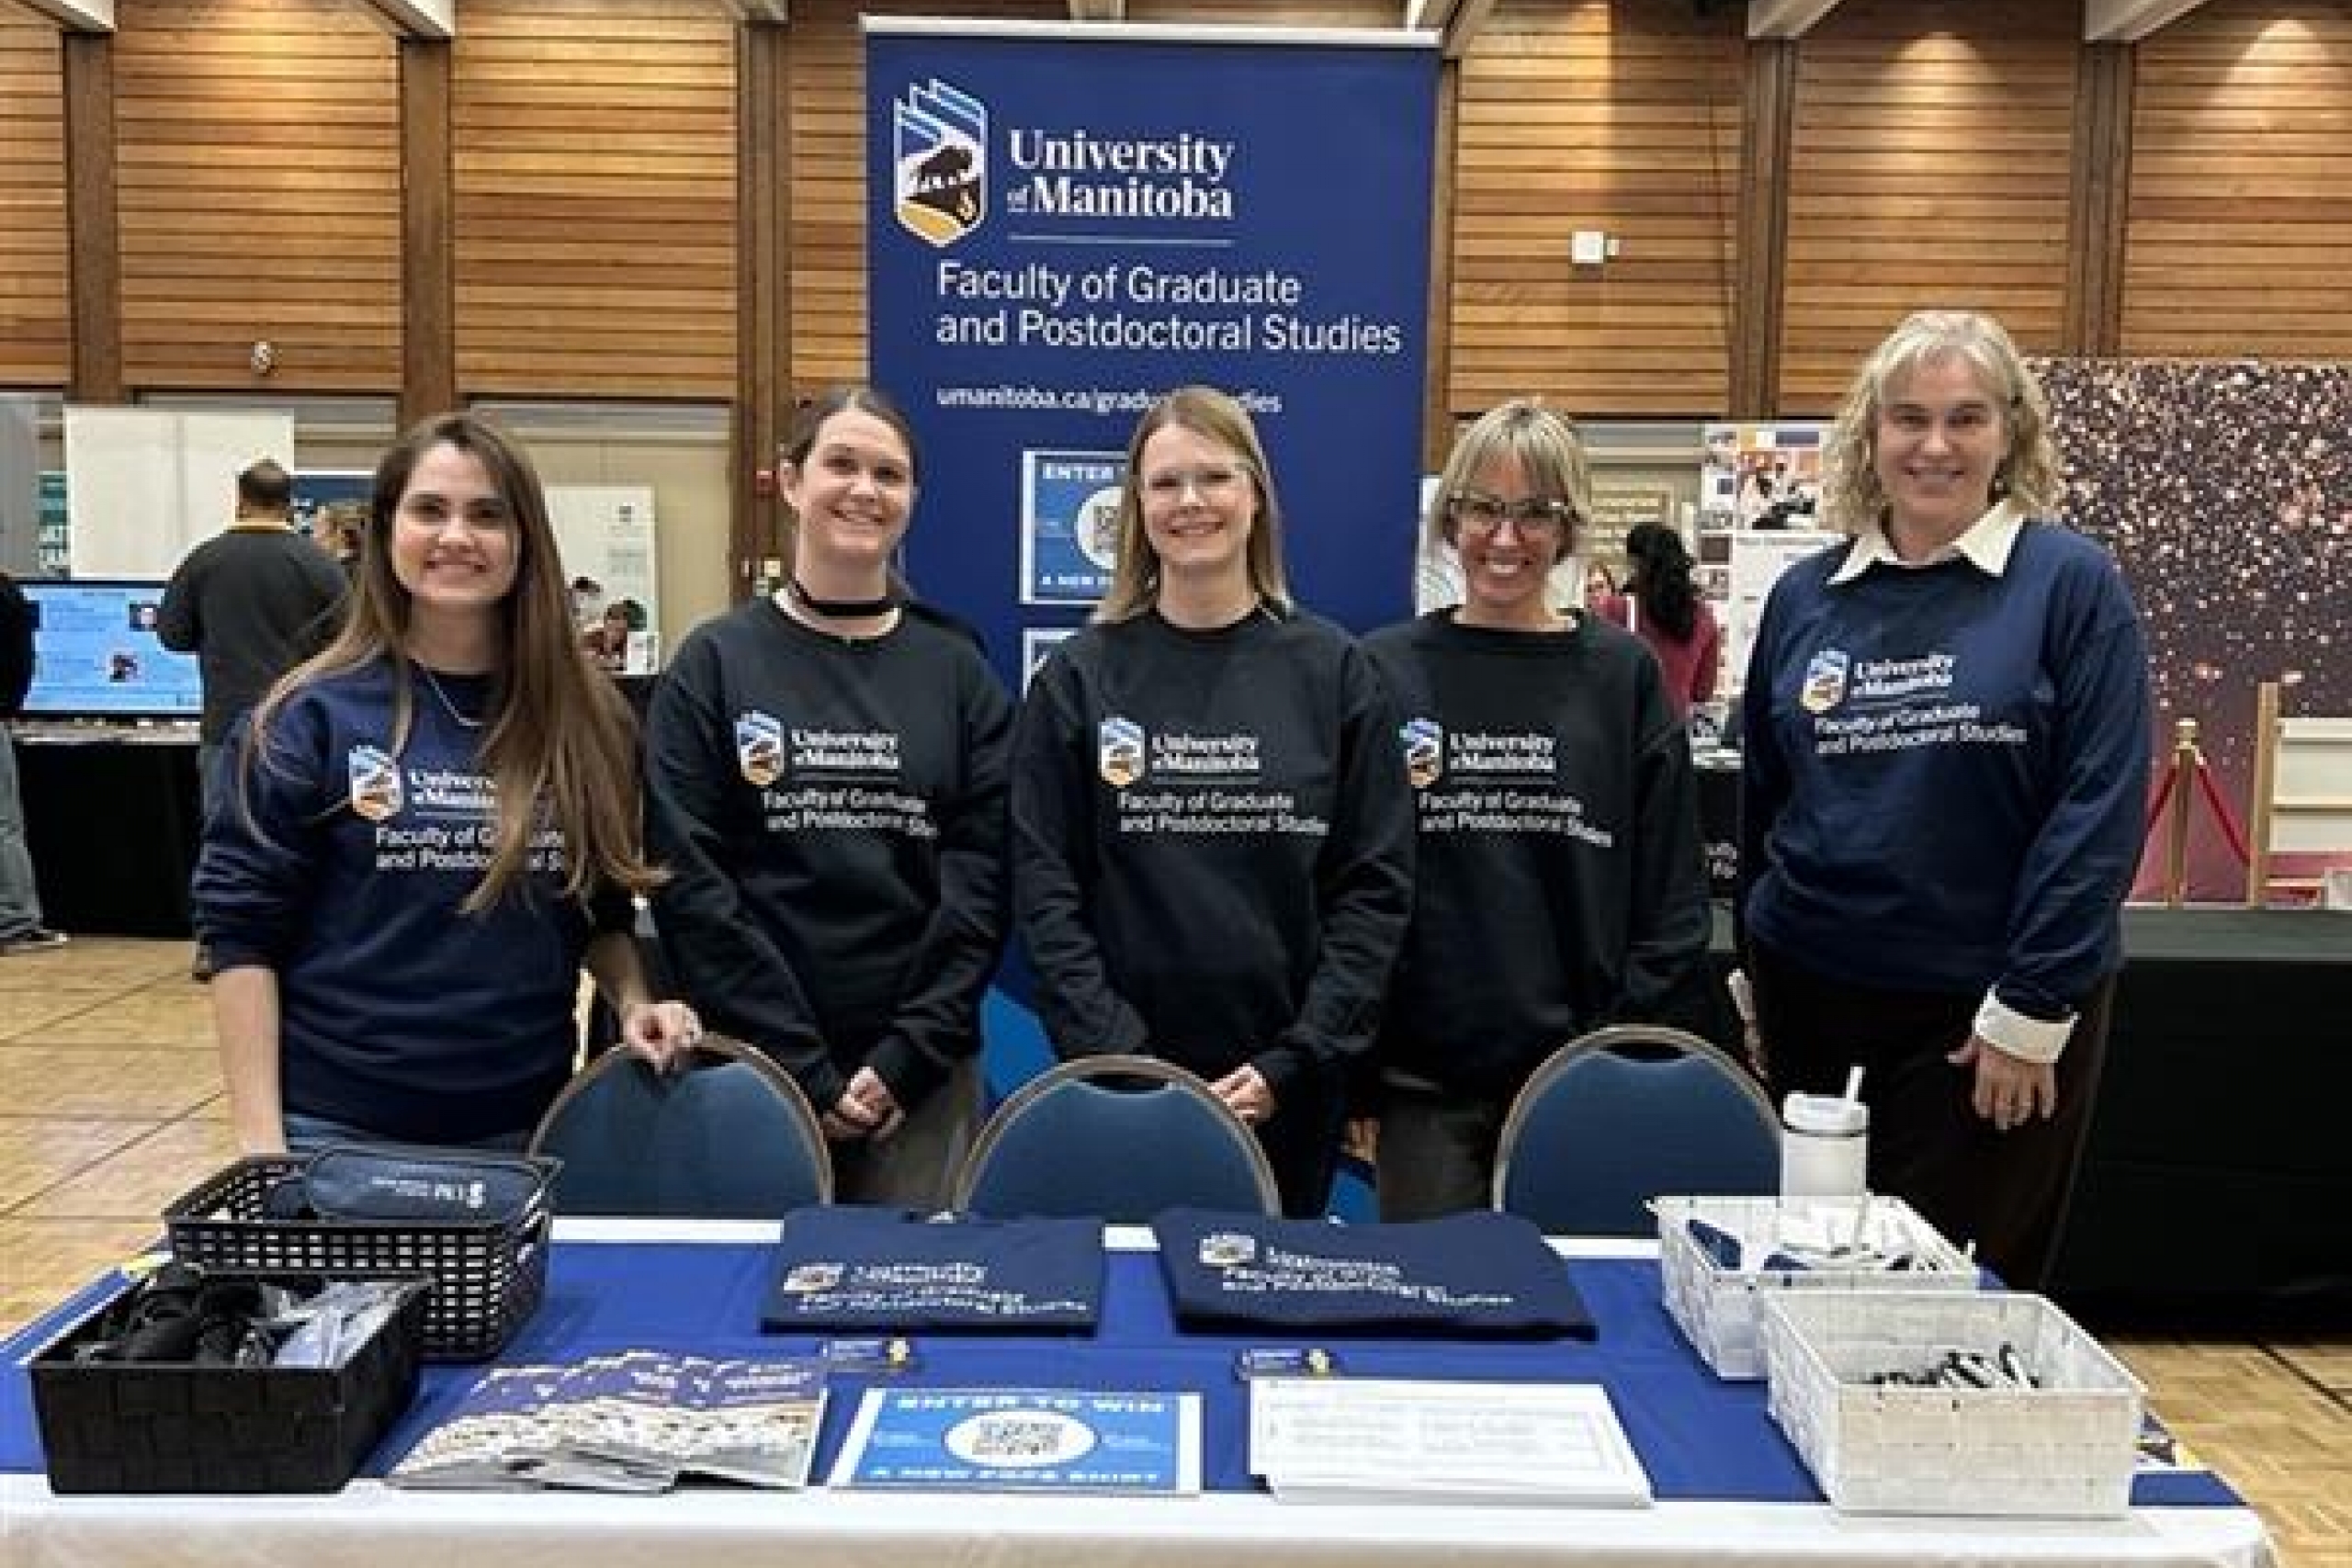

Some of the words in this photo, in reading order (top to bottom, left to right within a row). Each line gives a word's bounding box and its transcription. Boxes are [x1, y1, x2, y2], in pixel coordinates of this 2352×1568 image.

[1010, 130, 1235, 179] University
[1033, 177, 1234, 219] Manitoba
[937, 262, 1072, 306] Faculty
[1080, 265, 1119, 301] of
[1127, 267, 1303, 304] Graduate
[935, 310, 1006, 345] and
[1019, 310, 1251, 350] Postdoctoral
[1262, 315, 1402, 353] Studies
[1117, 792, 1184, 812] Faculty
